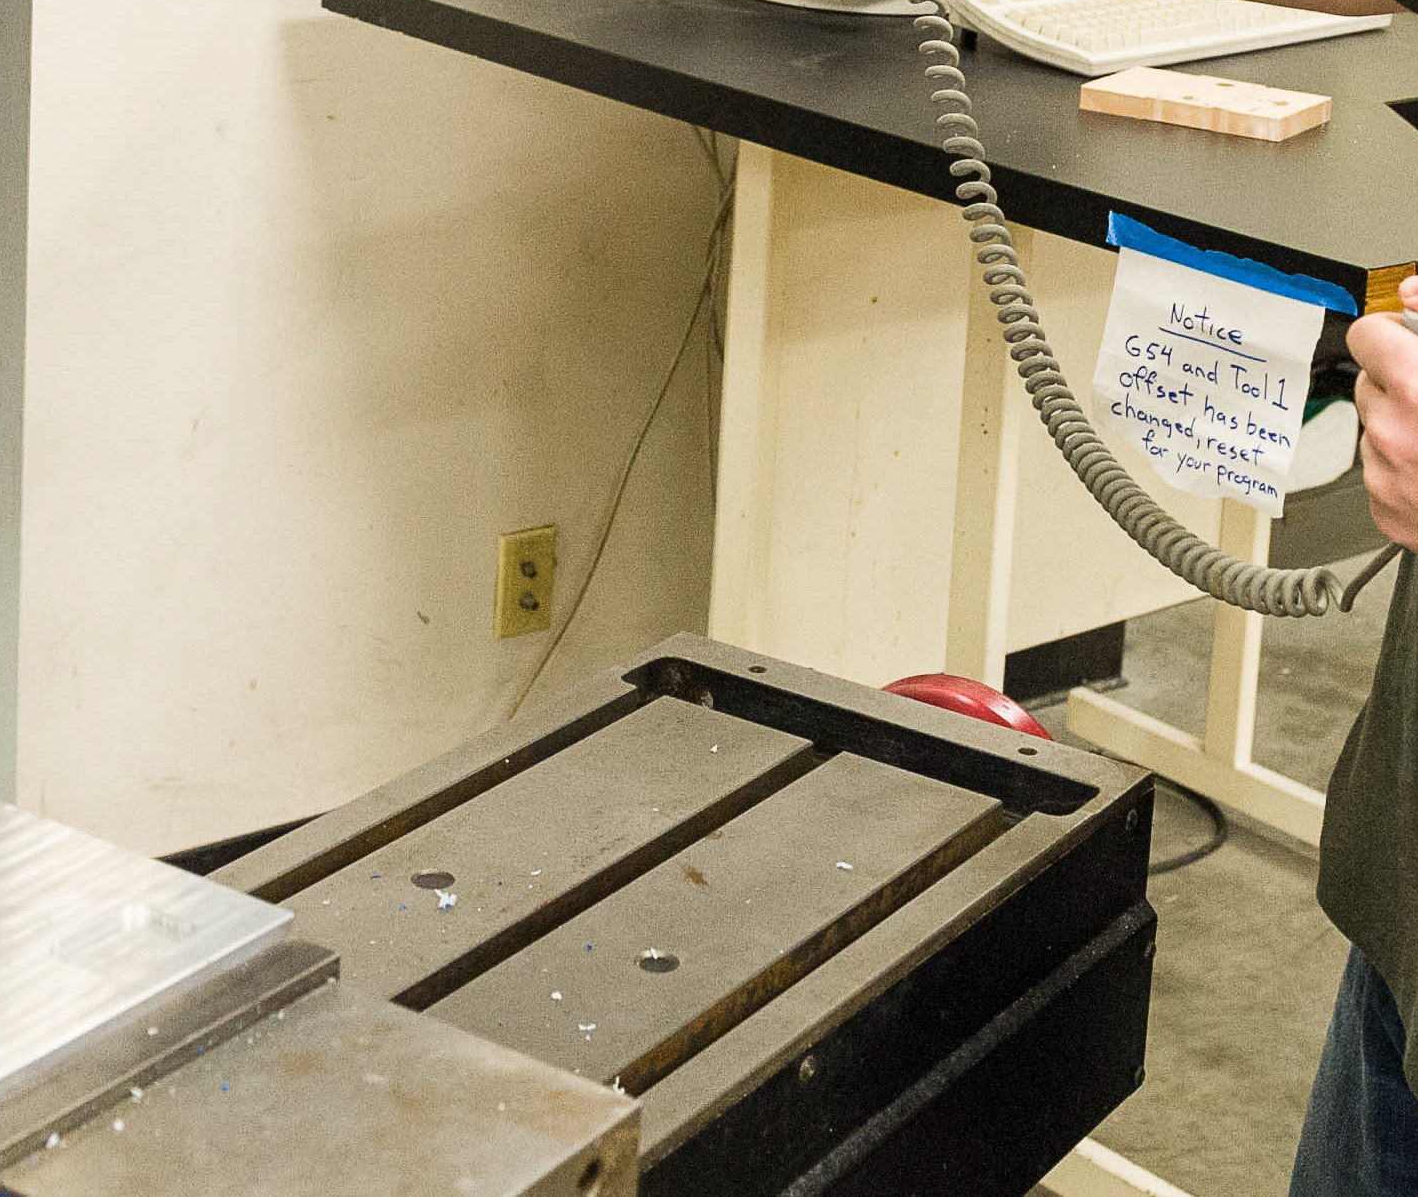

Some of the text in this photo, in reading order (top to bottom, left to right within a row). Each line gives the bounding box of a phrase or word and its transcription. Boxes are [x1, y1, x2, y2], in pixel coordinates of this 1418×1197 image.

[1170, 303, 1245, 346] Notice
[1118, 366, 1292, 449] offset has been
[1181, 360, 1220, 385] and
[1230, 363, 1269, 401] Tool
[1271, 377, 1290, 412] 1
[1141, 428, 1280, 499] for your program
[1206, 435, 1265, 466] reset
